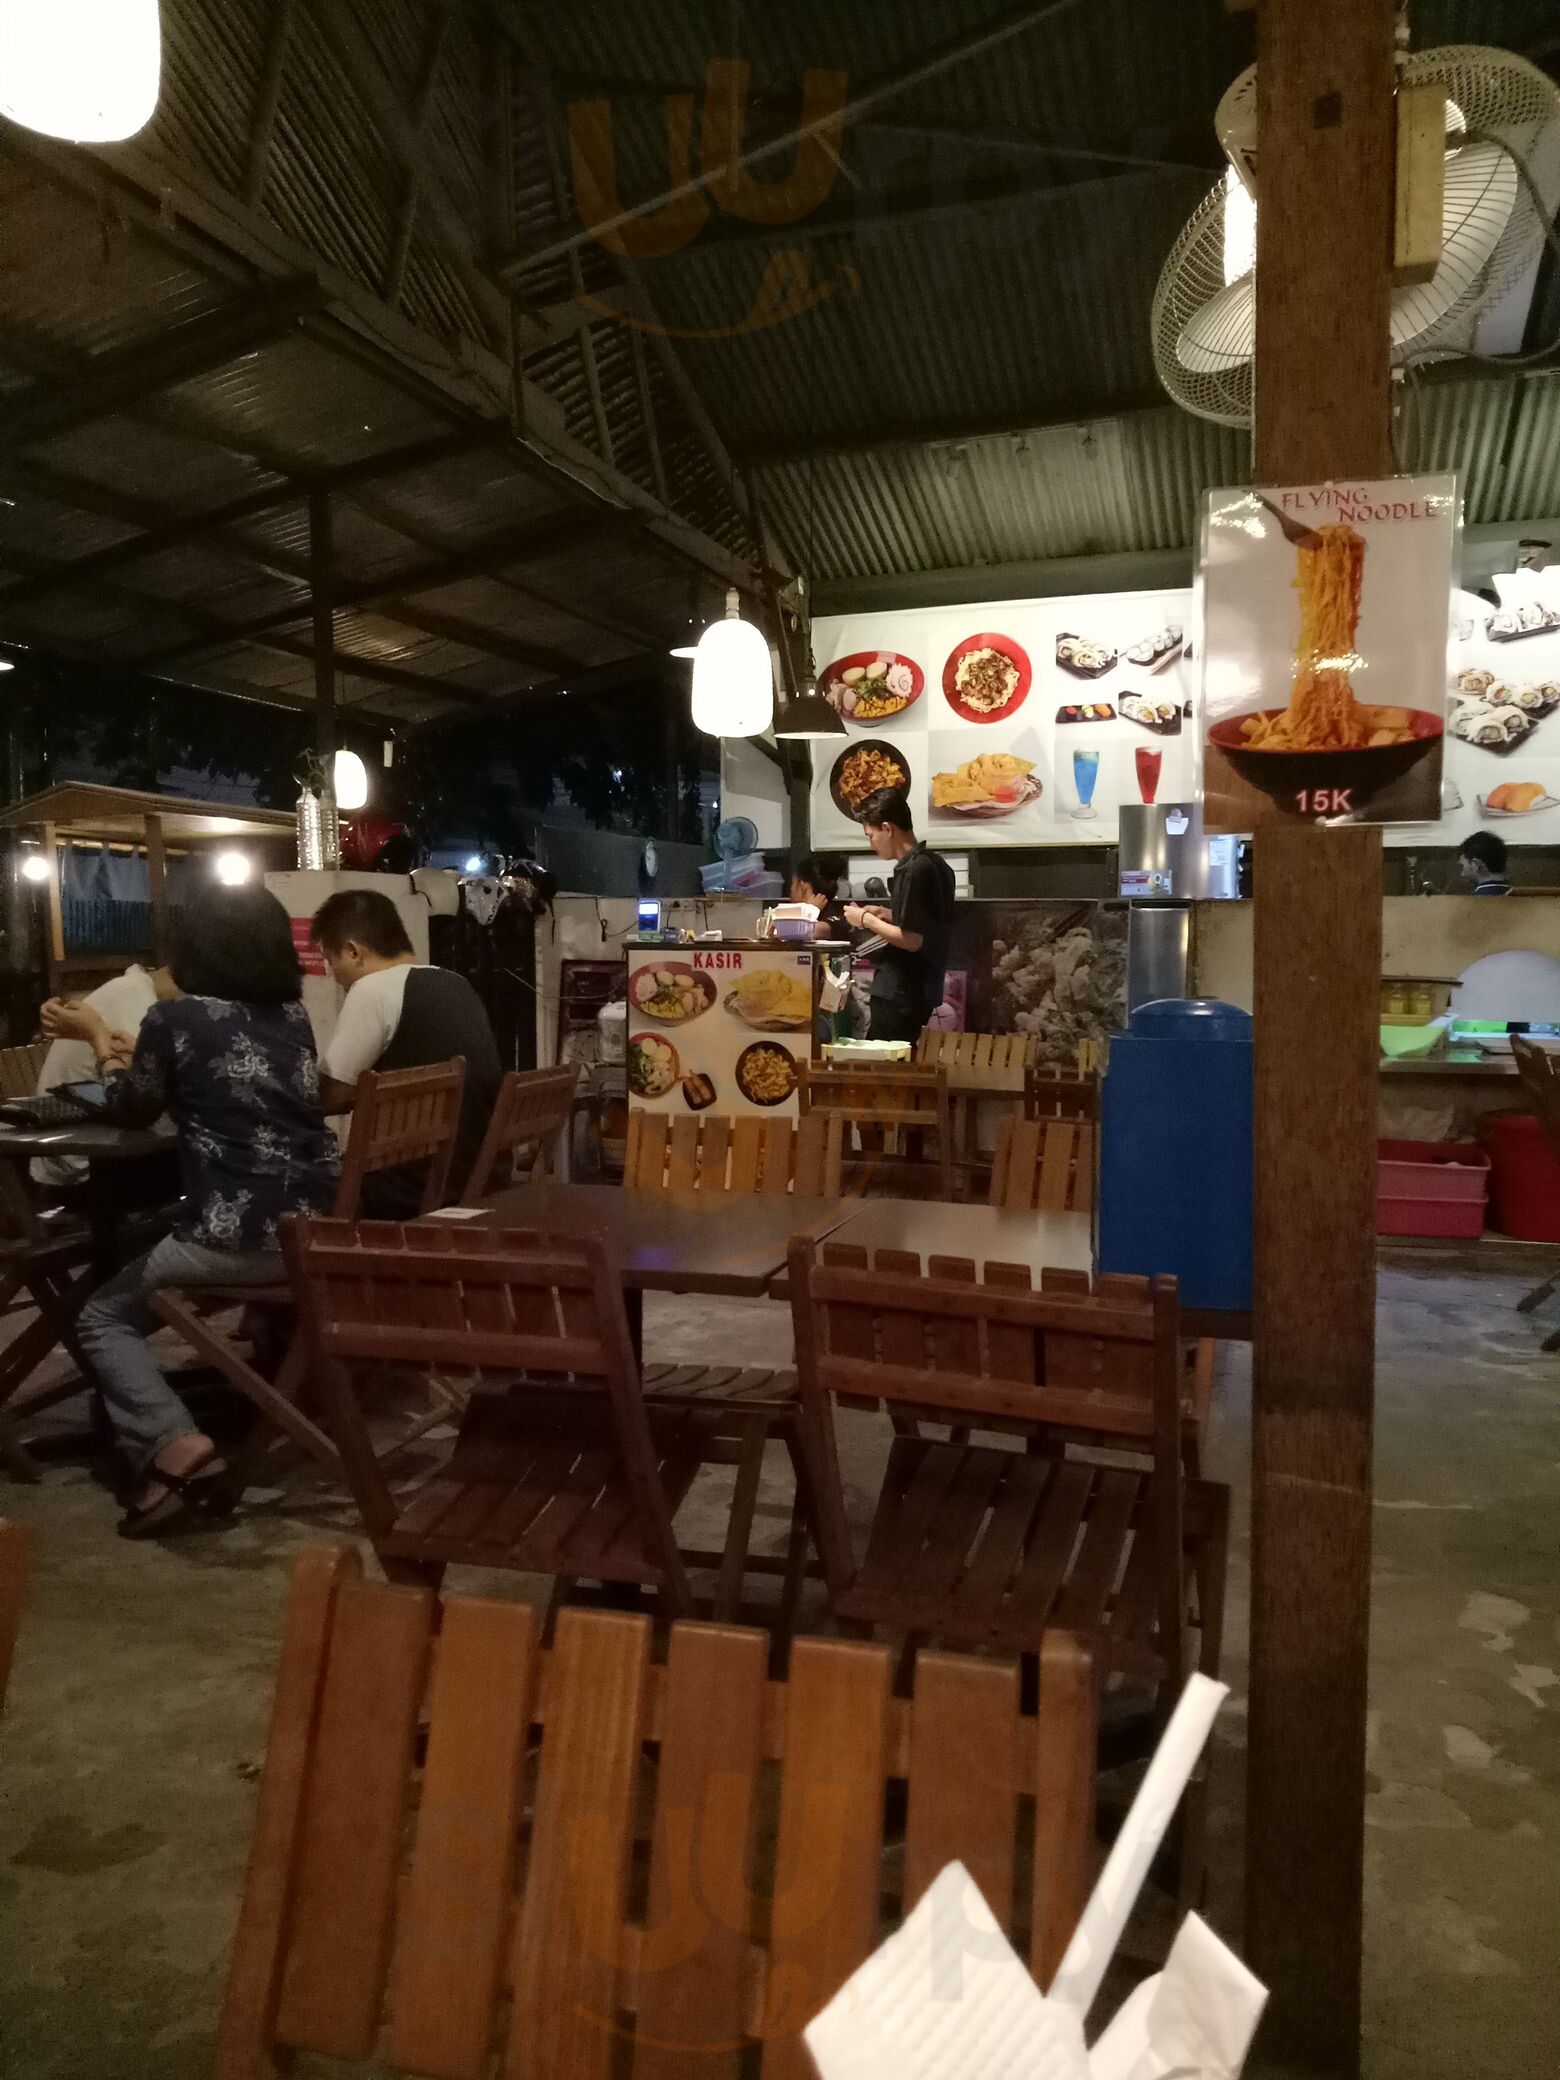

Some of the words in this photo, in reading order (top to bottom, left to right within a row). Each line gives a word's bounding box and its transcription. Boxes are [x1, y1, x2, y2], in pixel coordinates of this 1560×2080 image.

[1282, 487, 1368, 509] FLYING
[1338, 501, 1437, 523] NOODLE
[1295, 788, 1353, 813] 15K
[694, 952, 742, 969] KASIR
